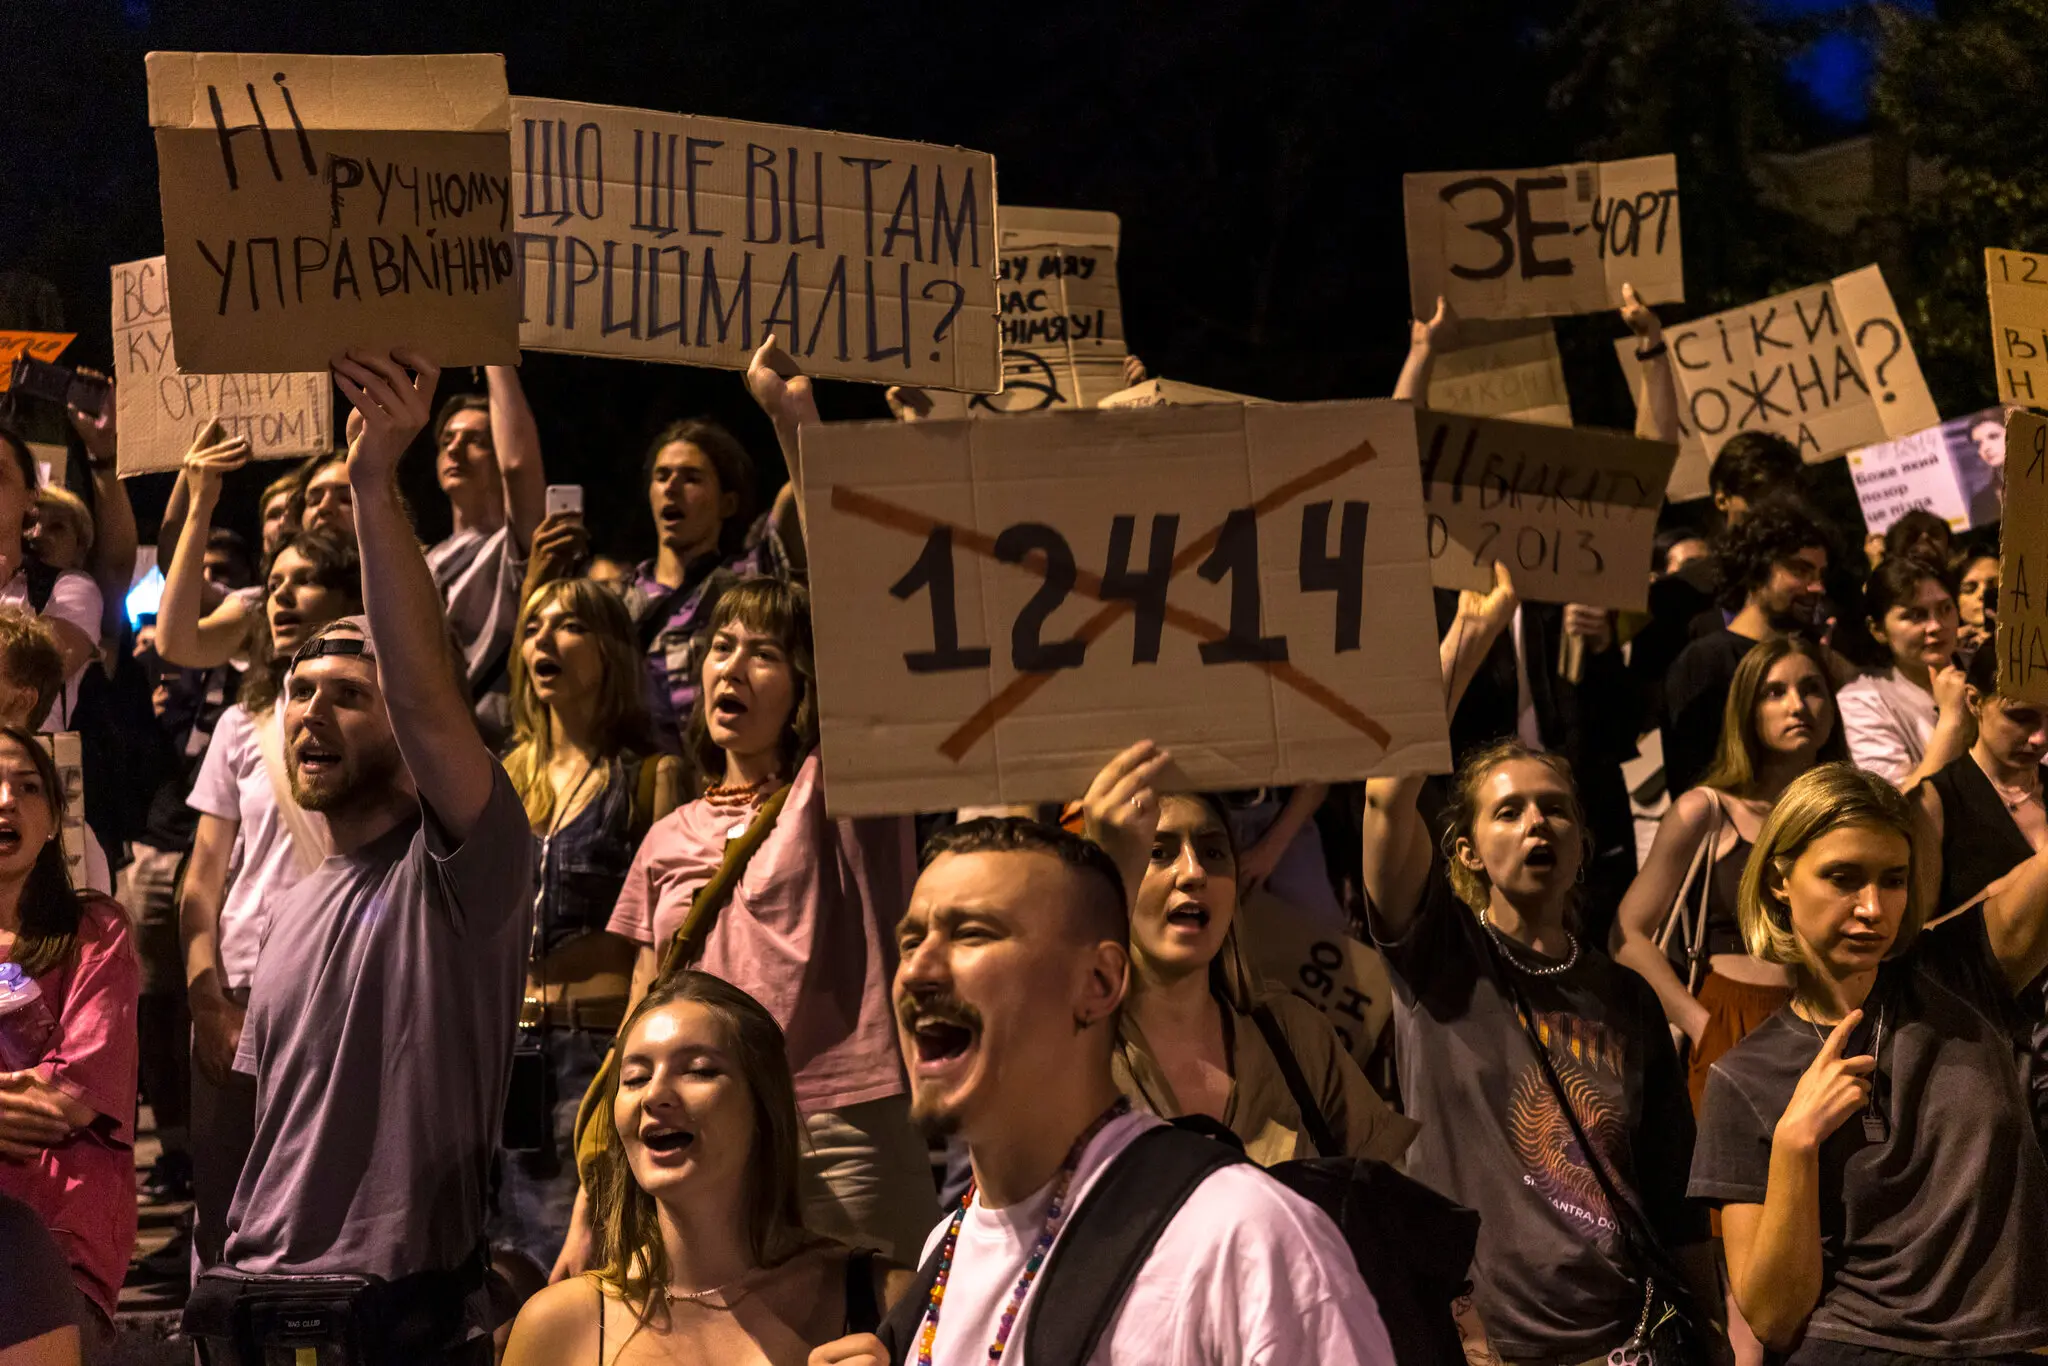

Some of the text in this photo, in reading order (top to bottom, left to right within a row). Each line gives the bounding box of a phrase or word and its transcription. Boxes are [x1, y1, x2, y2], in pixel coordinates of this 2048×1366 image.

[207, 72, 318, 191] НІ
[323, 152, 510, 233] РУЧНОМУ
[519, 118, 983, 269] ЩО ЩЕ ВИ ТАМ
[196, 228, 514, 316] УПРАВЛІННЮ
[513, 231, 966, 369] ПРИЙМАЛИ?
[1678, 317, 1903, 440] ОЖНА?
[888, 500, 1370, 673] 12414
[1472, 521, 1605, 575] 2013
[1548, 1197, 1596, 1225] ANTRA,
